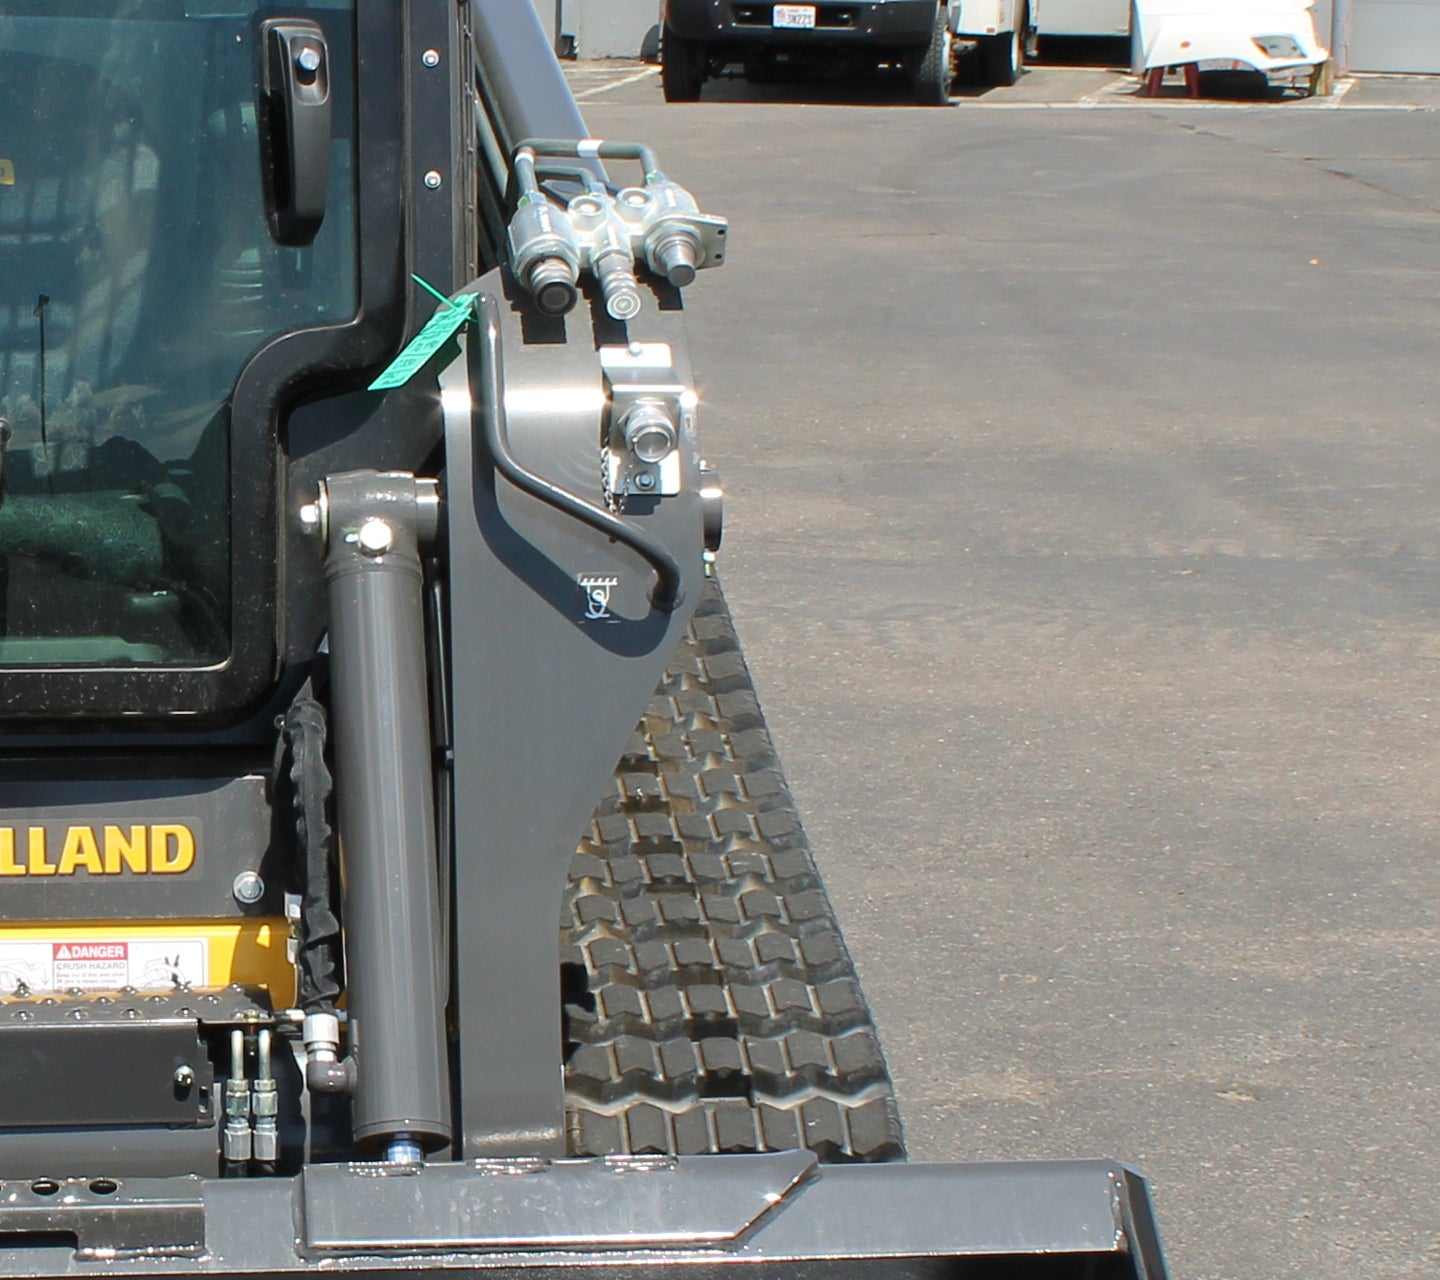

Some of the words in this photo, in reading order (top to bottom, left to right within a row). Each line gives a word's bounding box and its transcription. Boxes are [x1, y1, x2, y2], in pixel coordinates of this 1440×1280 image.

[71, 945, 125, 958] DANGER
[56, 962, 87, 970] CRUSH
[88, 961, 126, 970] HAZARD
